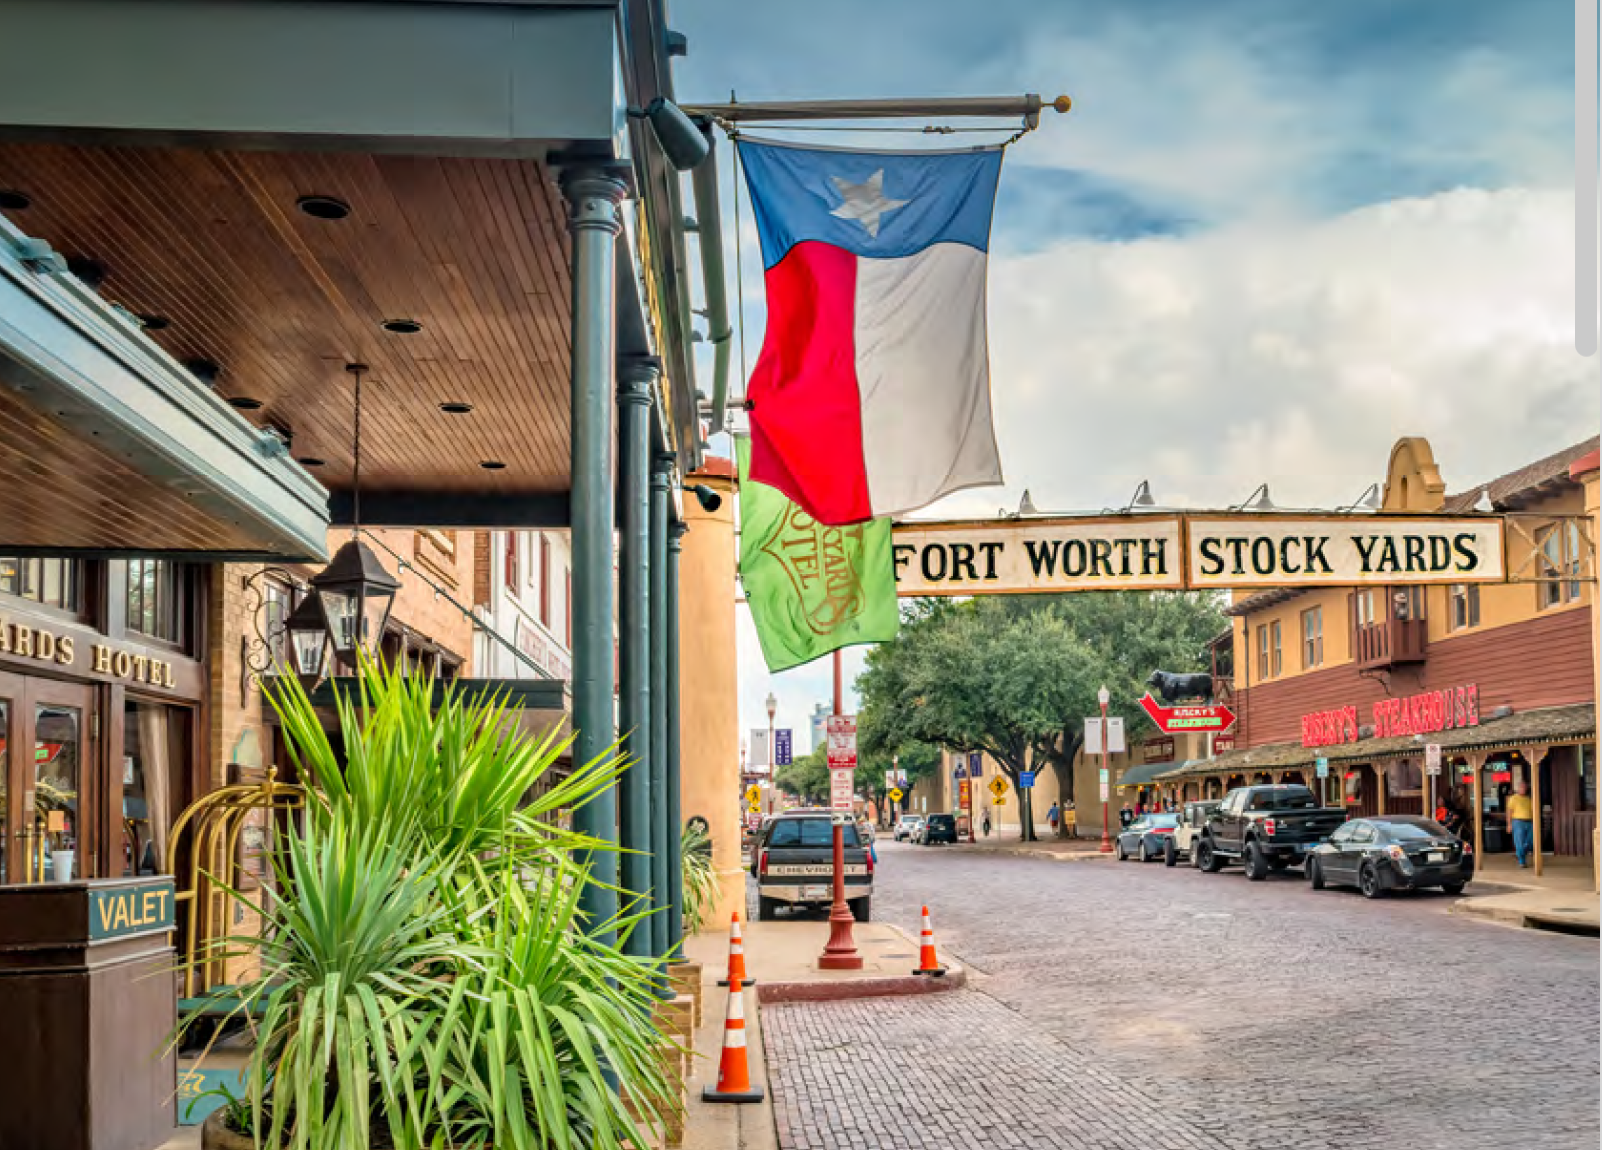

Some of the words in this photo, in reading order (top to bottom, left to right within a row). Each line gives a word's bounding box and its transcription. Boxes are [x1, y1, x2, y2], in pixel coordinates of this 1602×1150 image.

[892, 541, 1004, 583] FORT
[1023, 538, 1169, 578] WORTH
[1199, 536, 1334, 575] STOCK
[1350, 533, 1479, 572] YARDS
[95, 644, 177, 688] HOTEL
[1372, 682, 1480, 738] STEAKHOUSE
[98, 888, 170, 932] VALET
